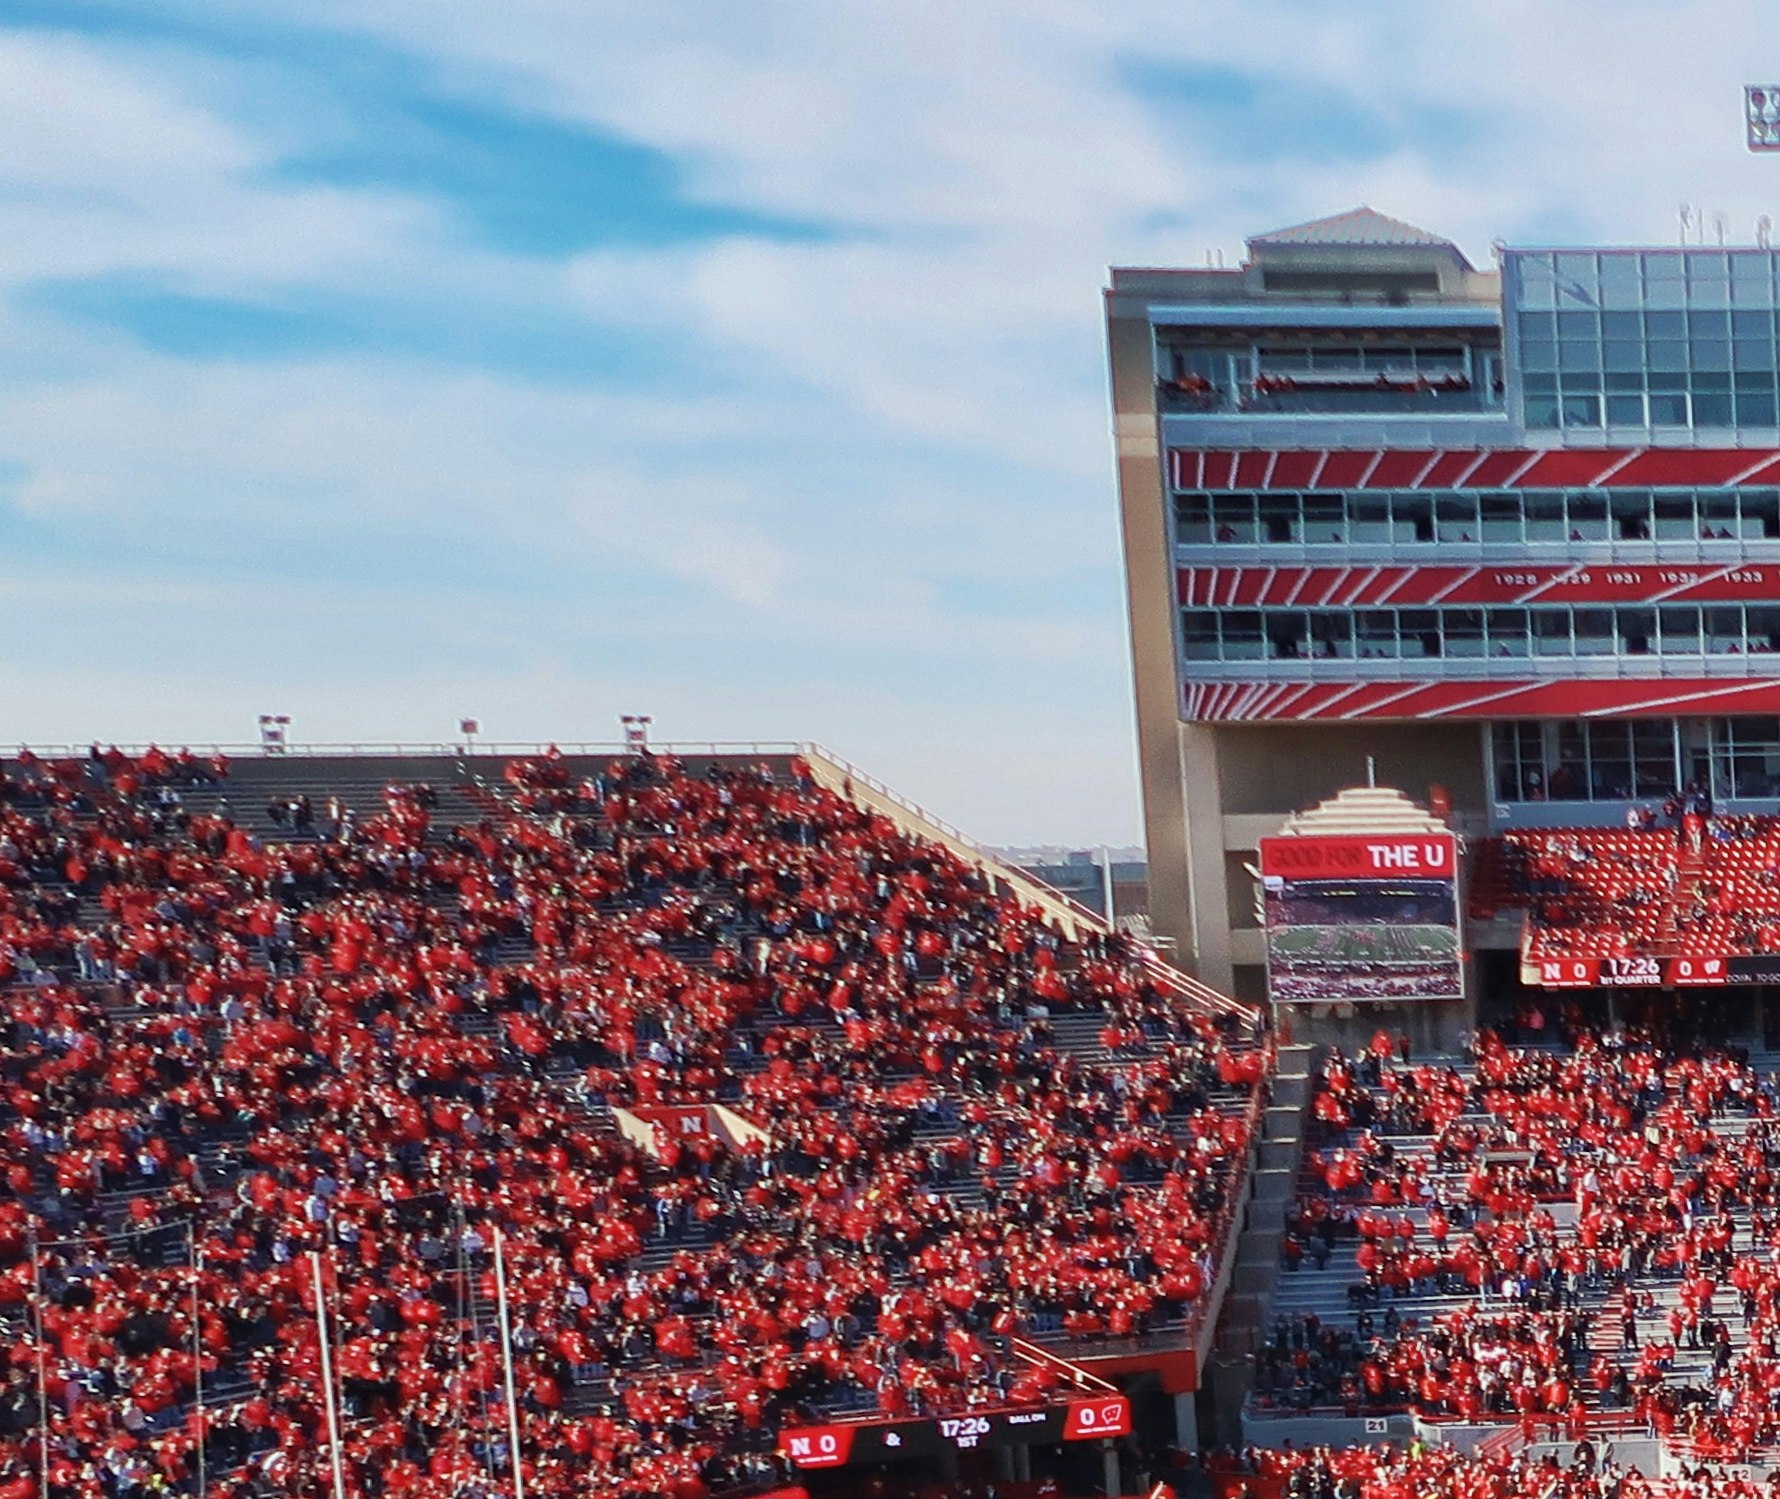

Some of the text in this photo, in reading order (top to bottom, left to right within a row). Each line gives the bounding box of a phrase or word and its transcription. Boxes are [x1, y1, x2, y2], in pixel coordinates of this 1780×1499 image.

[1366, 844, 1445, 867] THE U
[1543, 963, 1561, 980] N
[1572, 963, 1586, 979] 0
[1609, 958, 1660, 976] 17:26
[1679, 961, 1691, 976] 0
[1080, 1407, 1094, 1426] 0
[941, 1416, 991, 1438] 17:26
[790, 1437, 810, 1457] N
[819, 1434, 837, 1454] 0
[957, 1435, 979, 1448] 1ST
